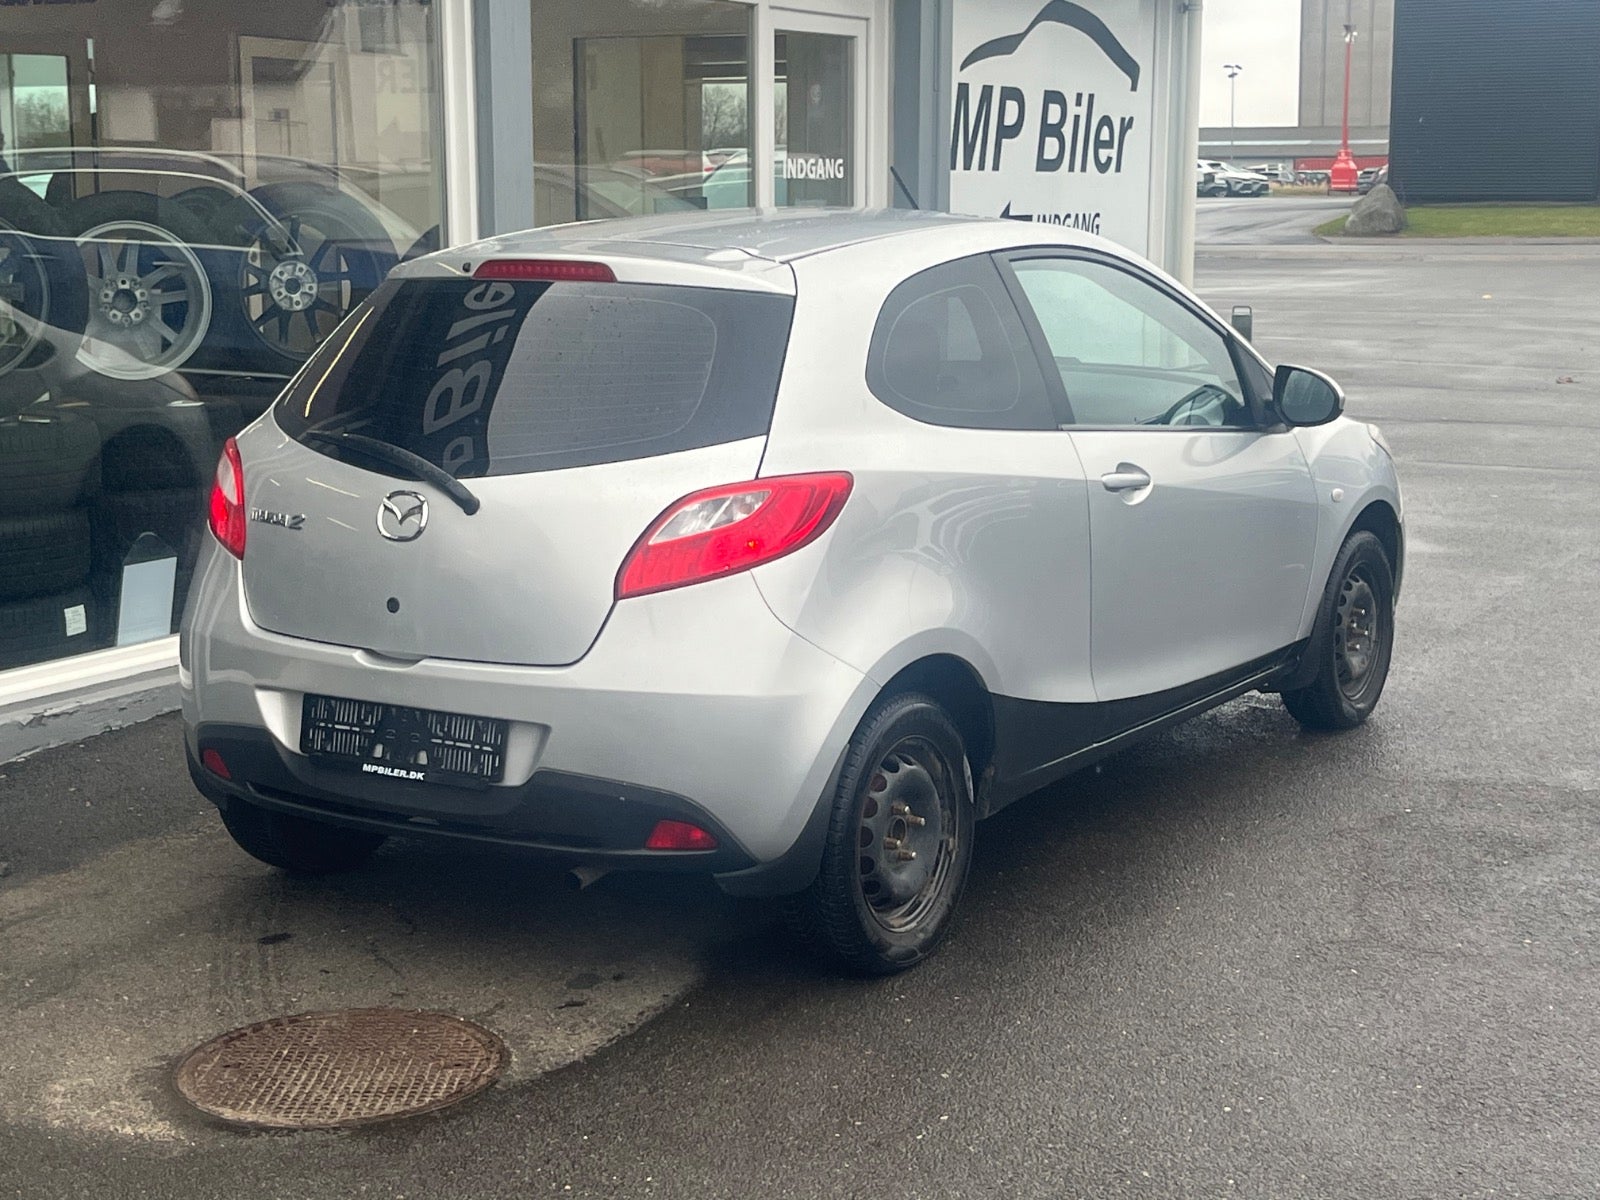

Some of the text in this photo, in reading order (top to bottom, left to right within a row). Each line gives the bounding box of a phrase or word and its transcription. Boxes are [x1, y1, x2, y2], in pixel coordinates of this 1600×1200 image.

[950, 82, 1135, 174] MP Biler
[783, 158, 844, 179] INDGANG
[362, 763, 425, 781] MPBILER.DK
